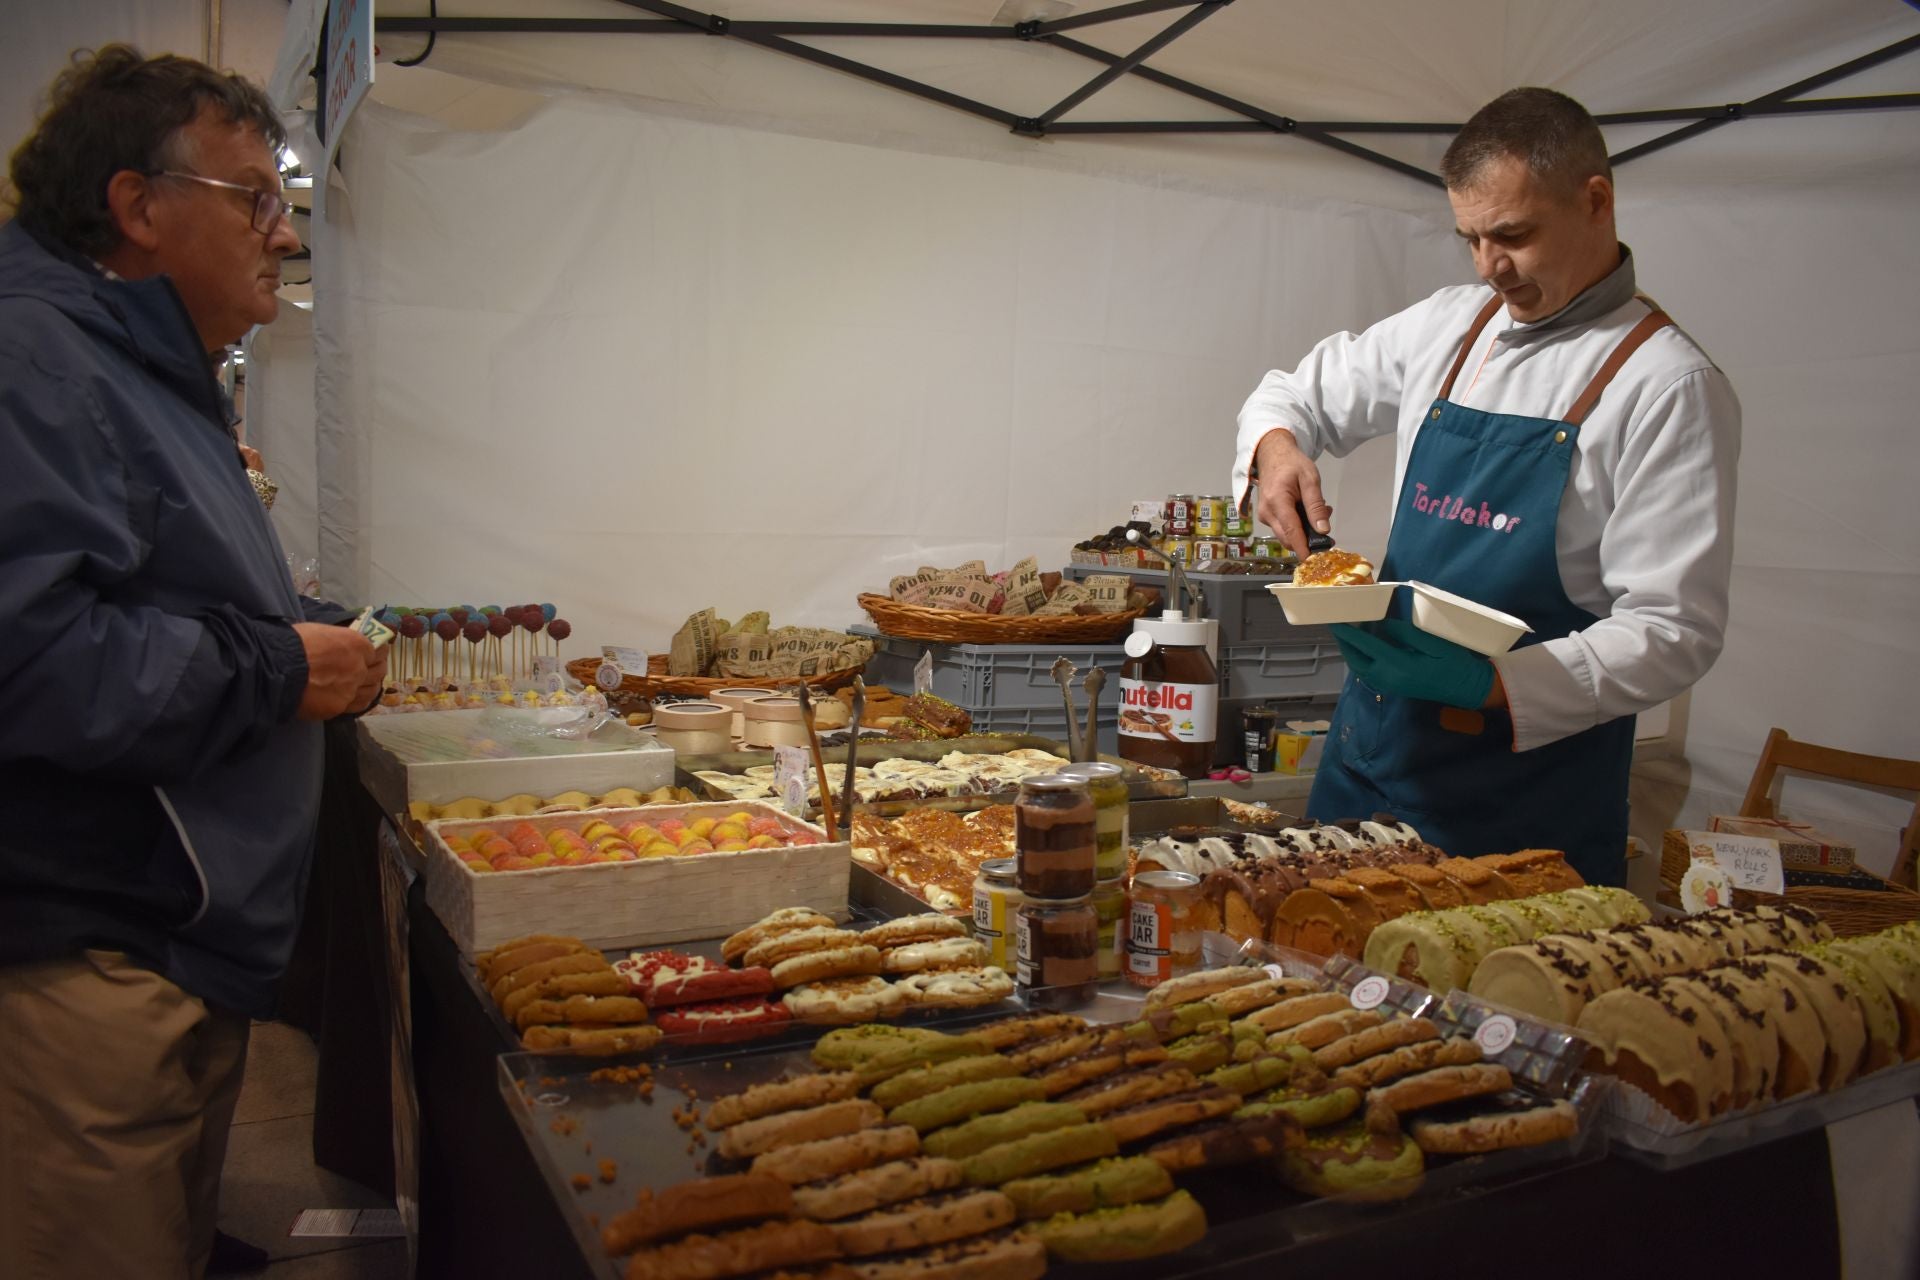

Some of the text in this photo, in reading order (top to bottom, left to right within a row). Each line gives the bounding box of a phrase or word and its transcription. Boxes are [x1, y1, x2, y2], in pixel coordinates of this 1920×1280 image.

[1119, 685, 1193, 711] nutella
[1734, 858, 1768, 872] ROLLS
[1744, 873, 1767, 885] 5€
[1132, 912, 1154, 927] CAKE
[1132, 926, 1153, 944] JAR
